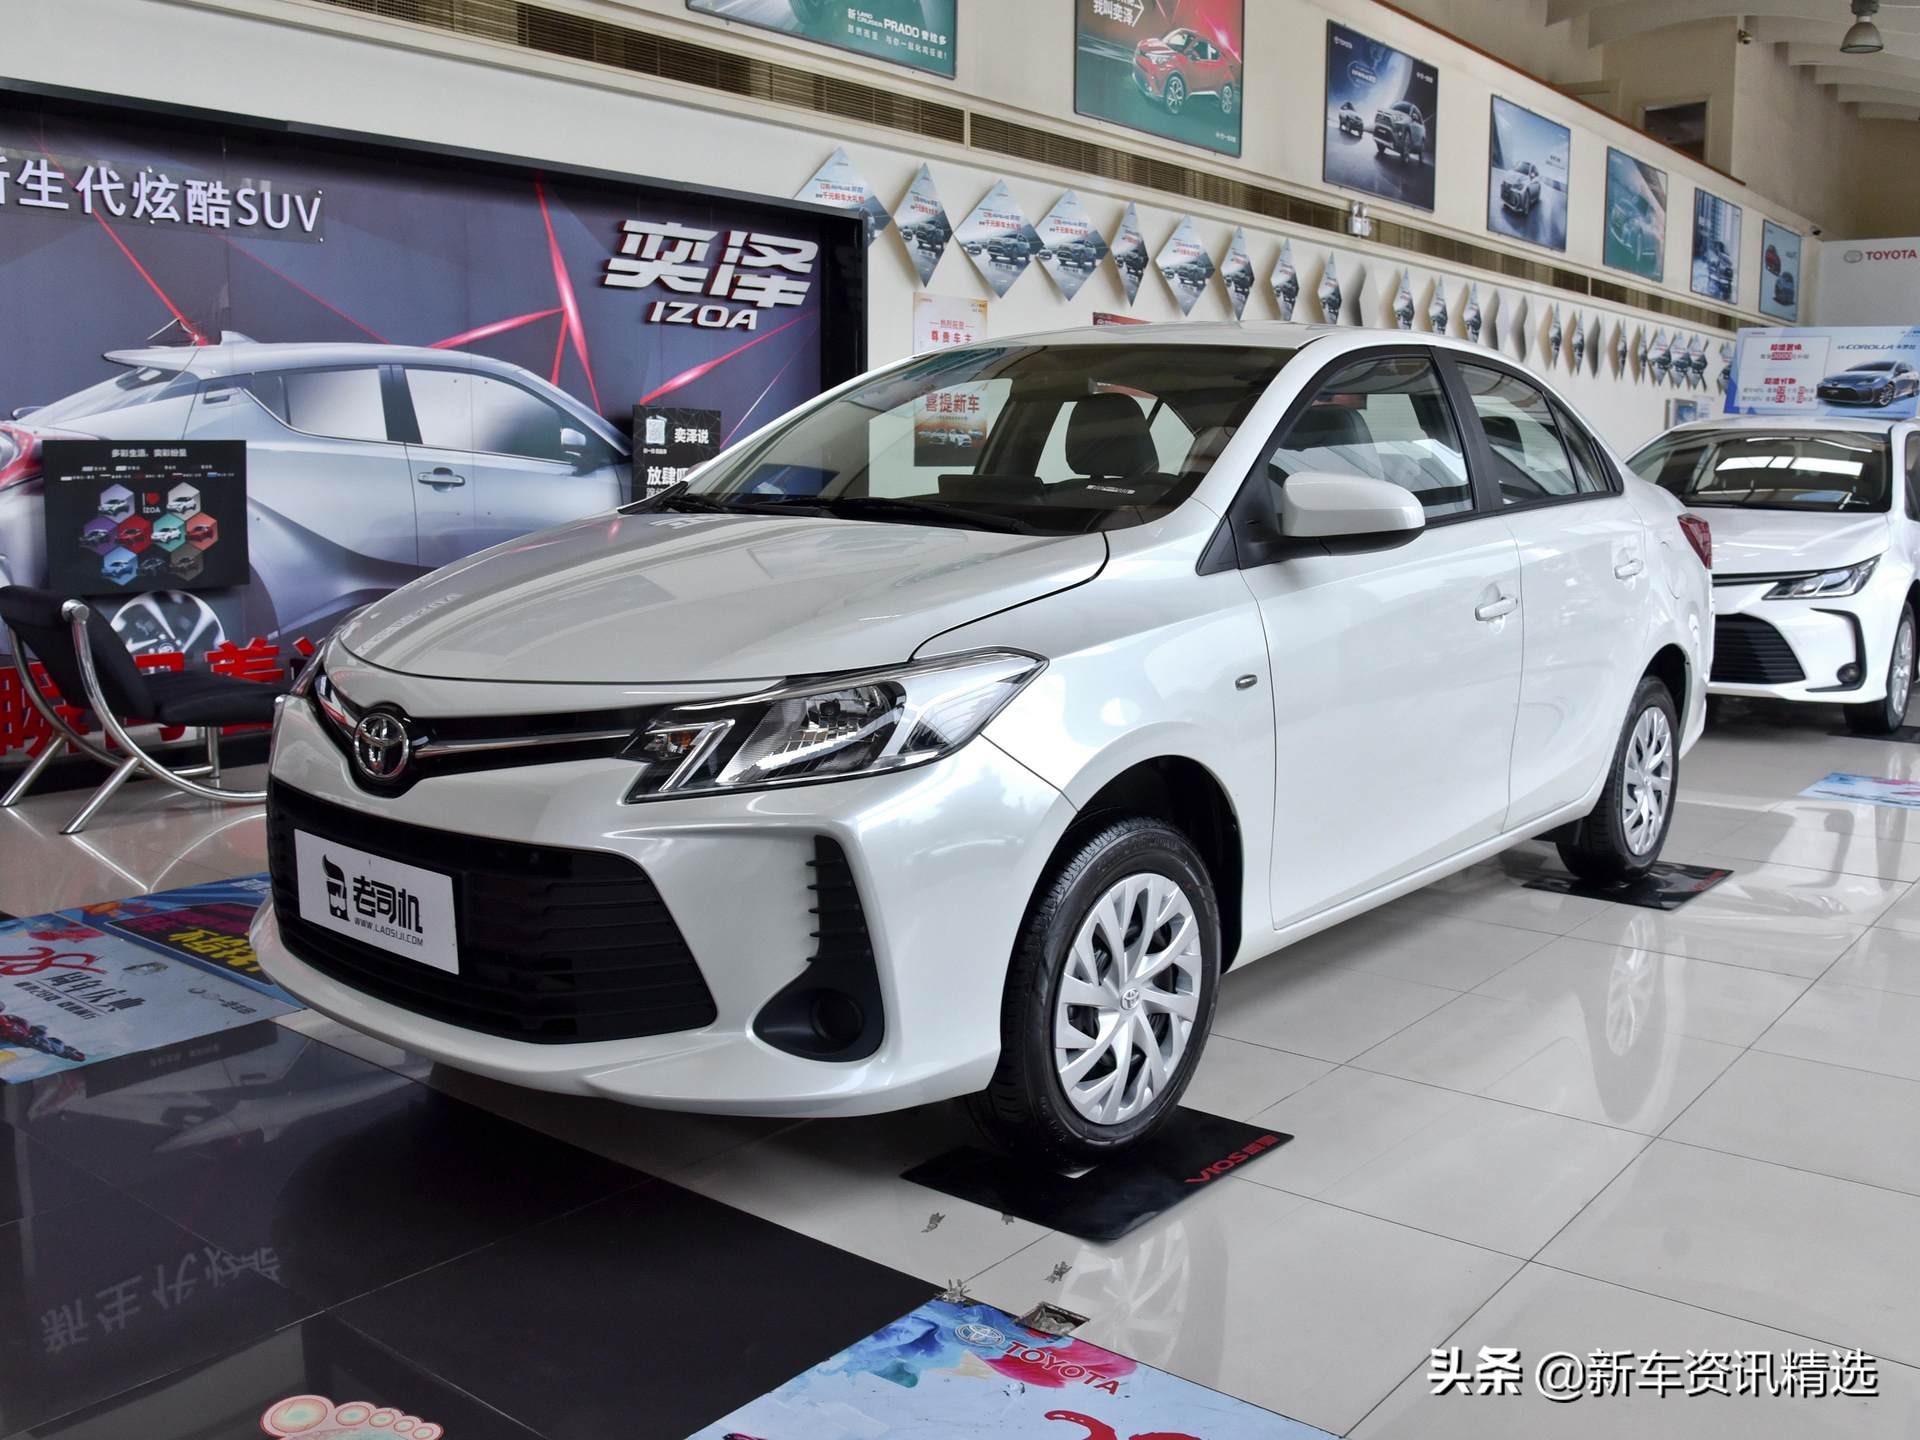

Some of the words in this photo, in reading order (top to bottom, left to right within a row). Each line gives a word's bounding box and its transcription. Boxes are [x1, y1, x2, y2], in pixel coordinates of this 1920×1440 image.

[884, 18, 920, 38] PRADO
[604, 219, 820, 309] 奕泽
[1864, 249, 1918, 262] TOYOTA
[649, 301, 759, 331] IZOA
[931, 330, 973, 344] 尊贵车主
[674, 427, 710, 444] 奕泽说
[352, 875, 424, 934] 老司机
[354, 917, 424, 947] WWW.LAOSIJI.COM
[1185, 1149, 1249, 1186] VIOS
[1005, 1340, 1121, 1397] TOYOTA
